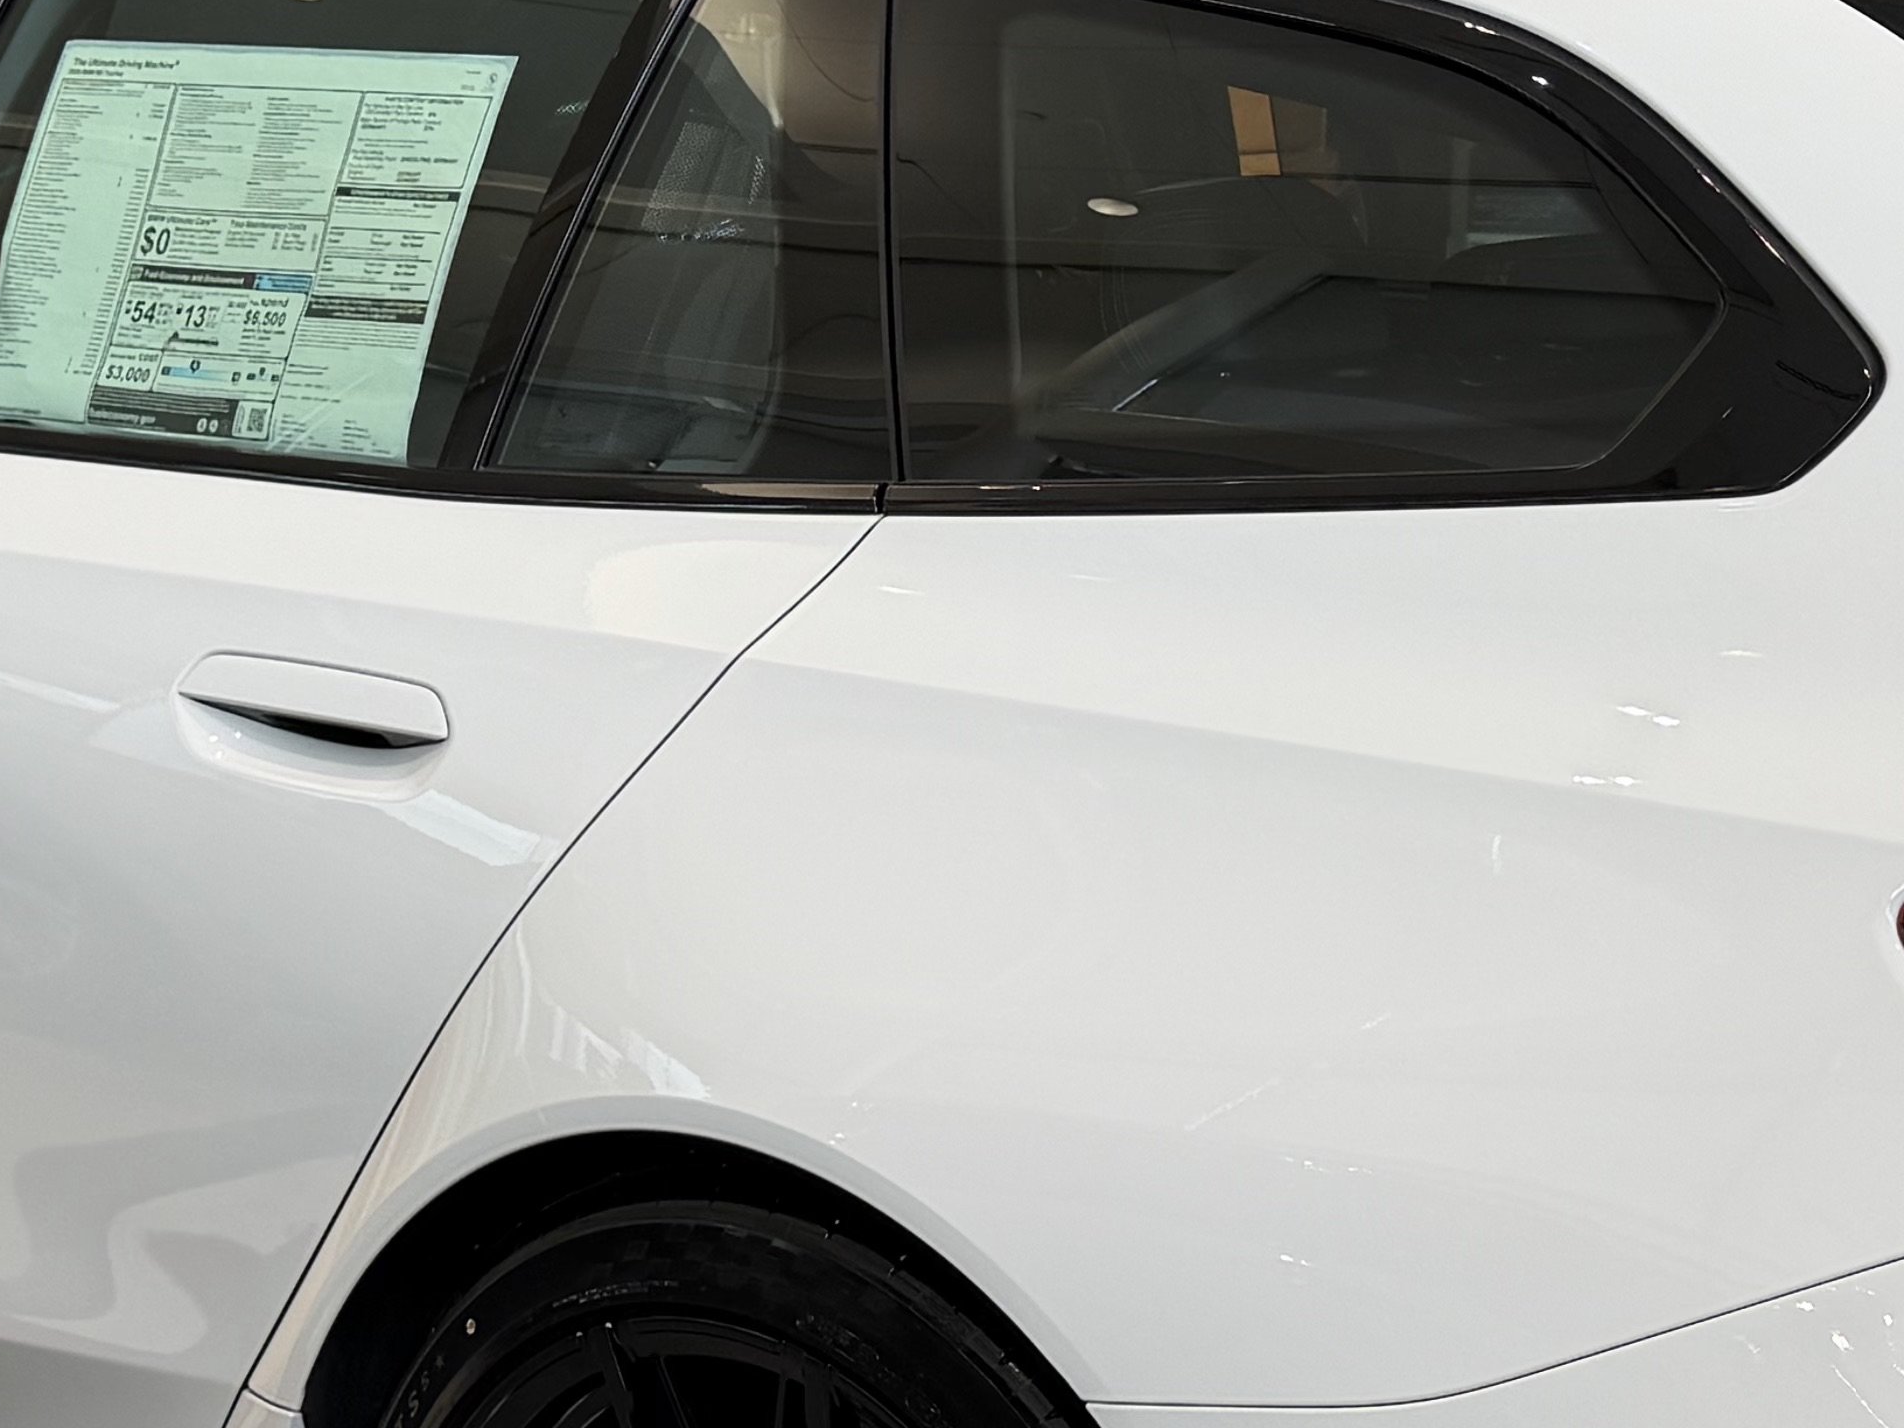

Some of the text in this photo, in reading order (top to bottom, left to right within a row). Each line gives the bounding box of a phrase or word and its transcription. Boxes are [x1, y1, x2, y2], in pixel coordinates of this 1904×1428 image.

[140, 225, 171, 257] $0
[130, 300, 158, 324] 54
[184, 304, 207, 329] 13
[243, 308, 287, 328] $6,500
[104, 363, 152, 384] $3,000
[406, 1388, 420, 1419] S
